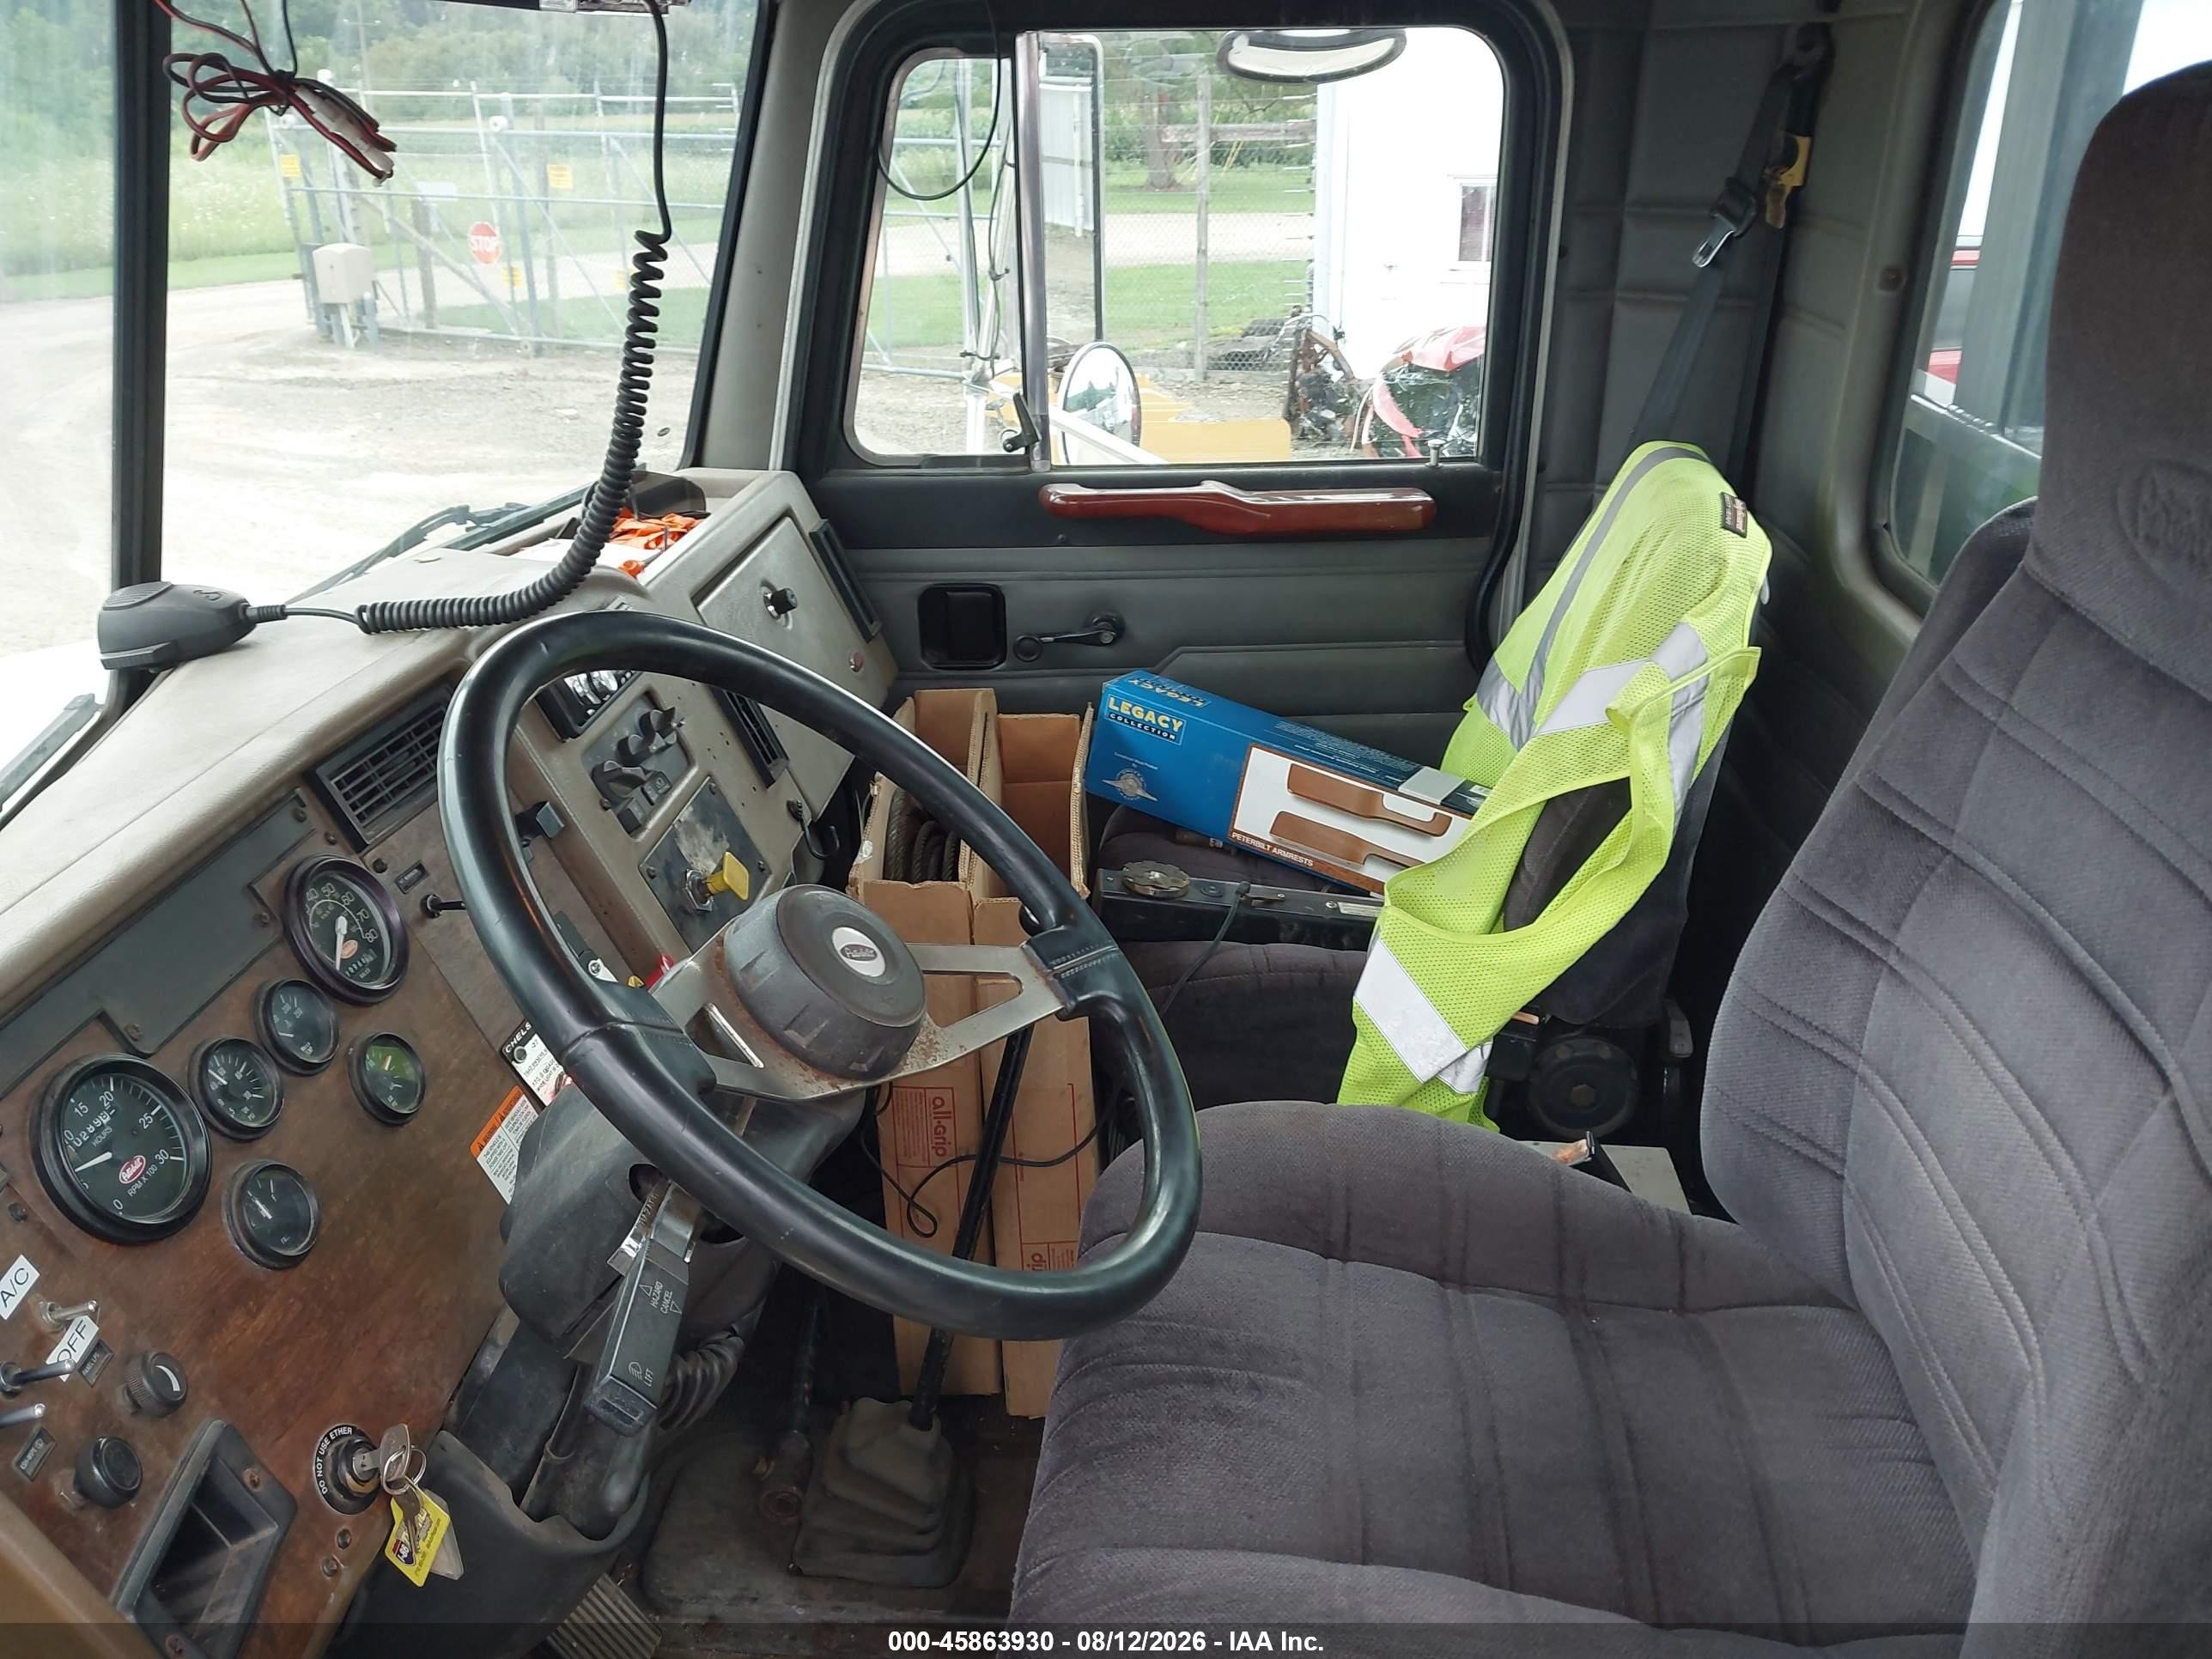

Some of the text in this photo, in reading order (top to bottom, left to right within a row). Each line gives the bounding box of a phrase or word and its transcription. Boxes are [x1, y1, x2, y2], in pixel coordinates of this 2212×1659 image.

[471, 236, 498, 252] STOP
[1107, 696, 1184, 733] LEGACY
[1108, 714, 1176, 741] COLLECTION
[1231, 832, 1314, 867] PETERBILT ARMRESTS
[99, 1091, 113, 1107] 20
[74, 1102, 88, 1116] 15
[139, 1113, 153, 1129] 25
[155, 1149, 169, 1164] 30
[127, 1180, 143, 1197] RPM
[146, 1164, 158, 1177] 100
[112, 1199, 124, 1210] 0
[1, 1267, 29, 1308] A/C
[650, 1281, 664, 1308] HAZARD
[660, 1291, 673, 1314] CANCEL
[57, 1320, 87, 1362] OFF
[643, 1368, 653, 1388] LIFT
[330, 1426, 353, 1440] ETHER
[319, 1438, 331, 1455] USE
[319, 1480, 328, 1495] DO
